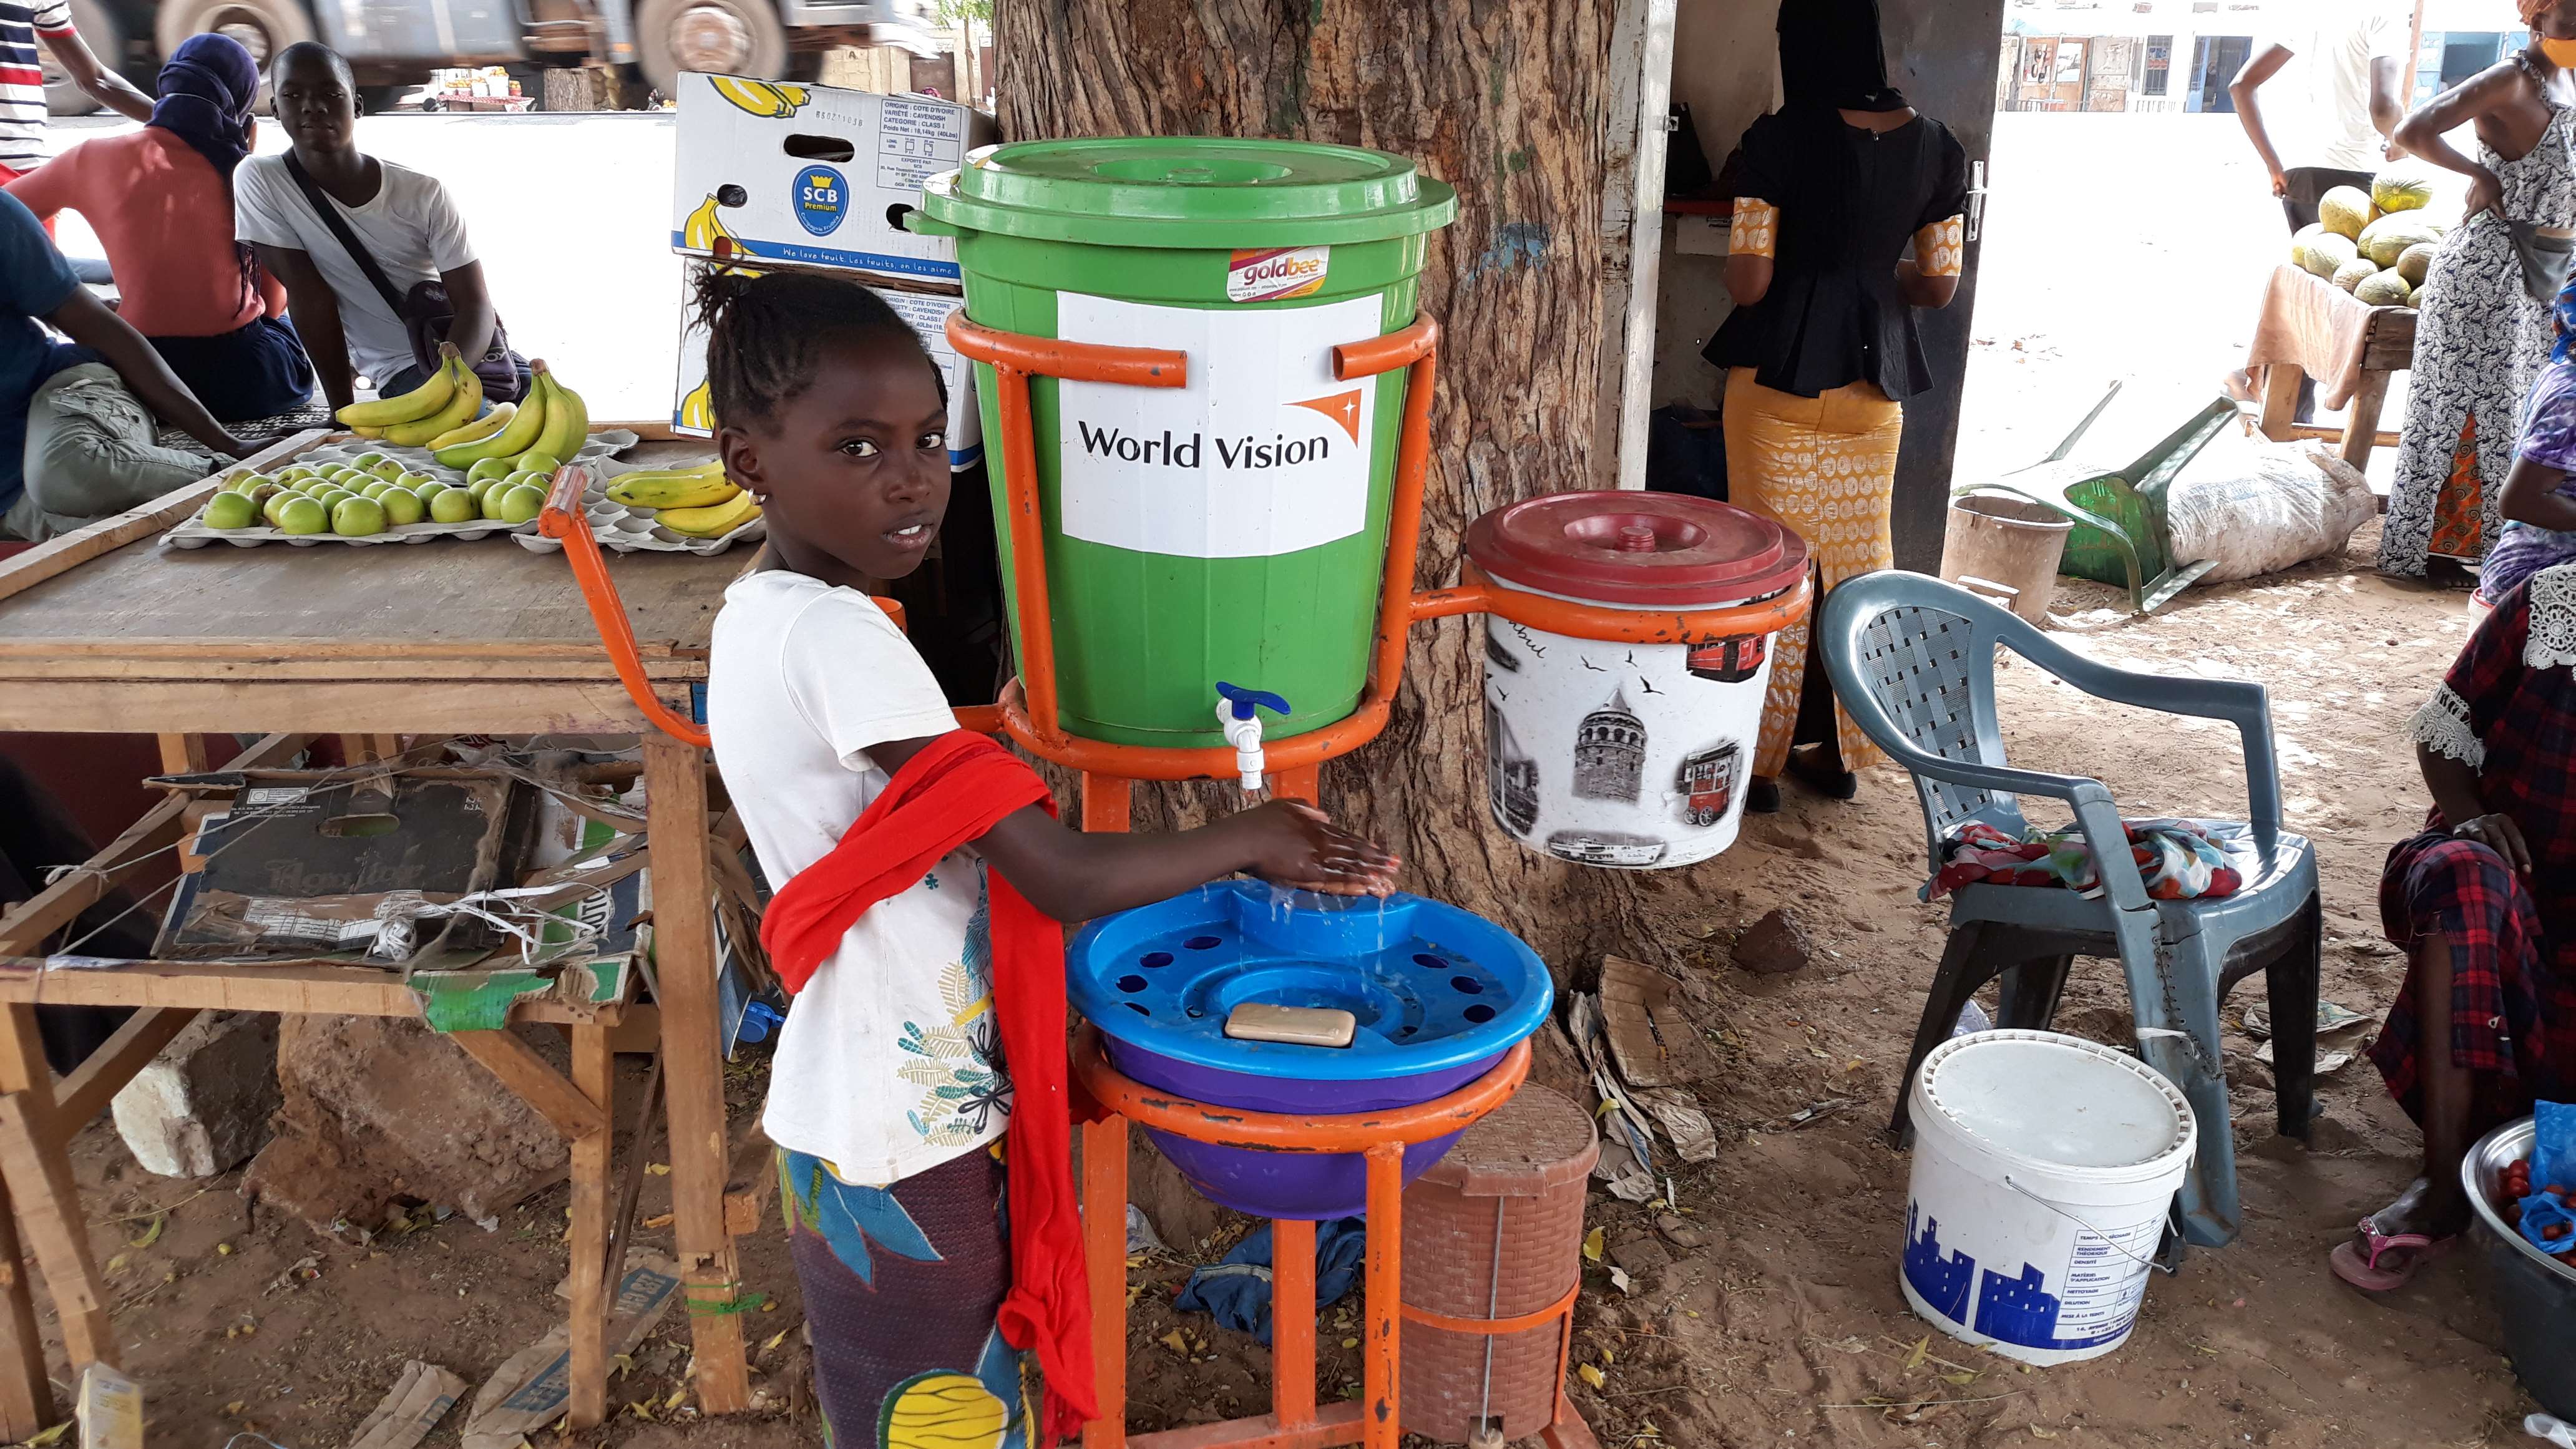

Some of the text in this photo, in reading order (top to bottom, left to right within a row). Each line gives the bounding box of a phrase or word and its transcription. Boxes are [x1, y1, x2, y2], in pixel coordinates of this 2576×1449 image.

[885, 102, 909, 110] ORIGINE
[930, 107, 955, 115] D'IVOIRE
[884, 117, 917, 125] CATEGORIE
[885, 109, 908, 117] VARIÉTÉ
[913, 112, 946, 122] CAVENDISH
[803, 187, 838, 203] SCB
[805, 202, 837, 211] Premium
[783, 247, 796, 256] We
[799, 249, 817, 260] love
[849, 254, 863, 264] Les
[914, 261, 927, 271] les
[1244, 256, 1319, 285] goldbee
[912, 306, 945, 315] CAVENDISH
[926, 301, 951, 310] D'IVOIRE
[919, 314, 938, 322] CLASS
[1078, 419, 1329, 469] World Vision
